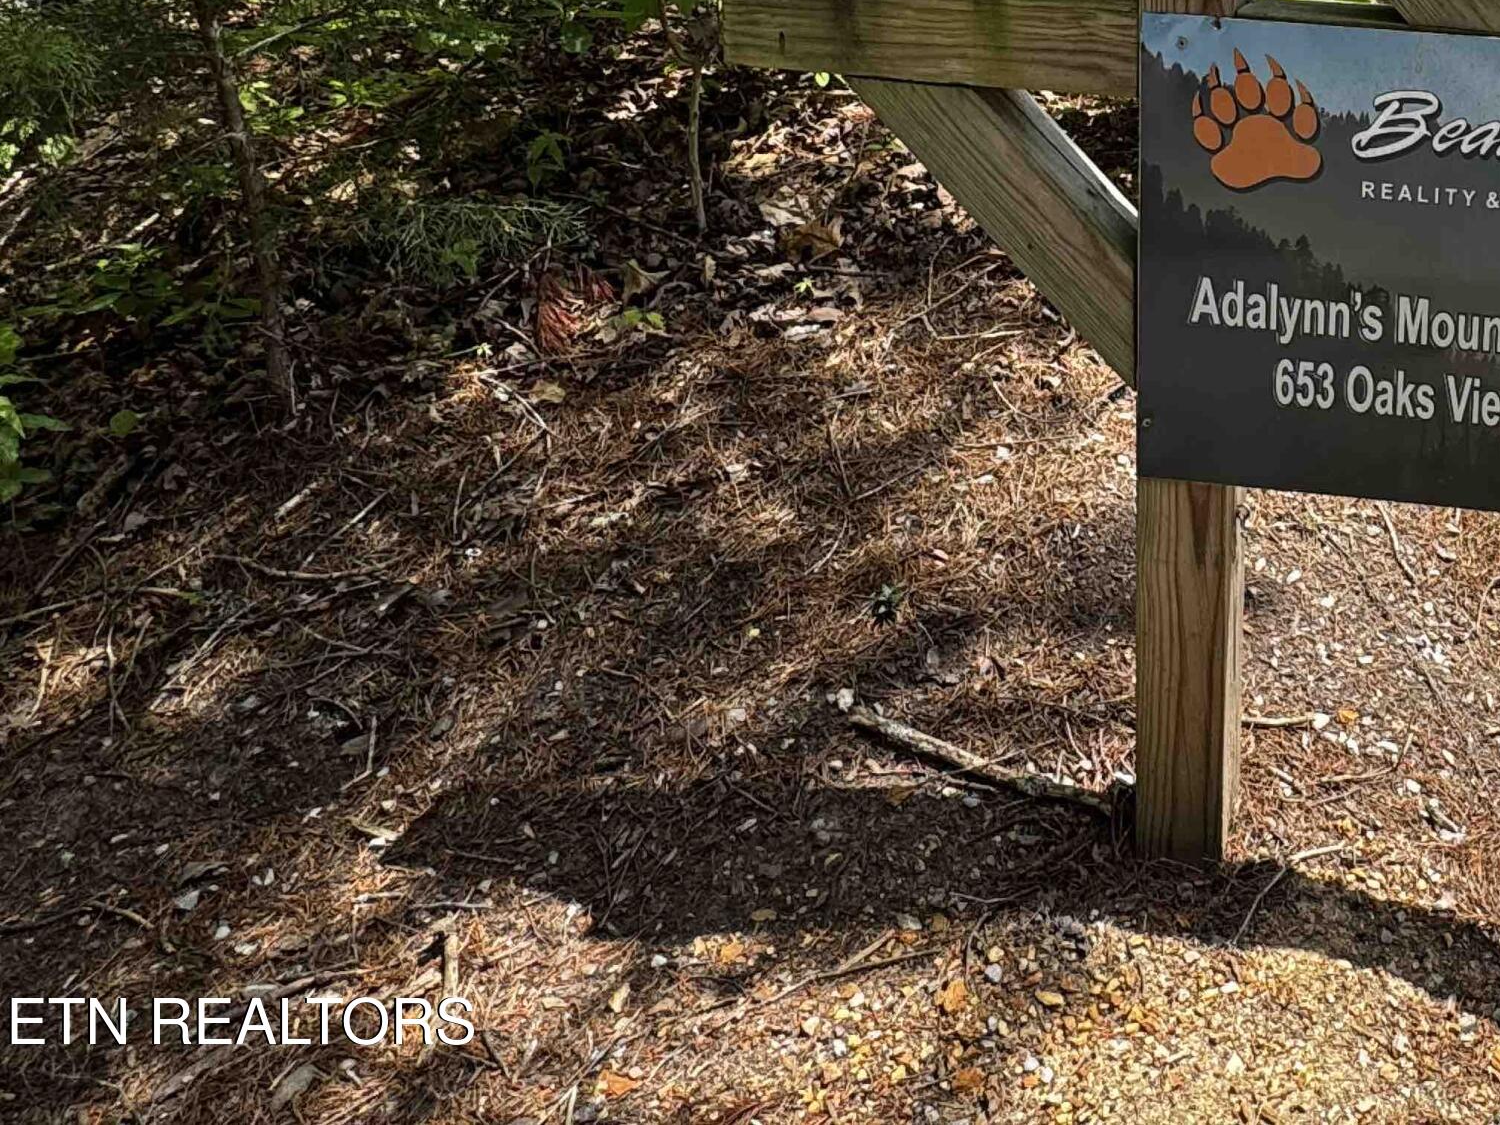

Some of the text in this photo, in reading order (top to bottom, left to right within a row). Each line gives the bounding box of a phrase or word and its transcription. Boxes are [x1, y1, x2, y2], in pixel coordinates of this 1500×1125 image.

[1361, 181, 1479, 208] REALITY
[1486, 190, 1500, 209] &
[1273, 359, 1335, 410] 653
[1346, 365, 1435, 420] Oaks
